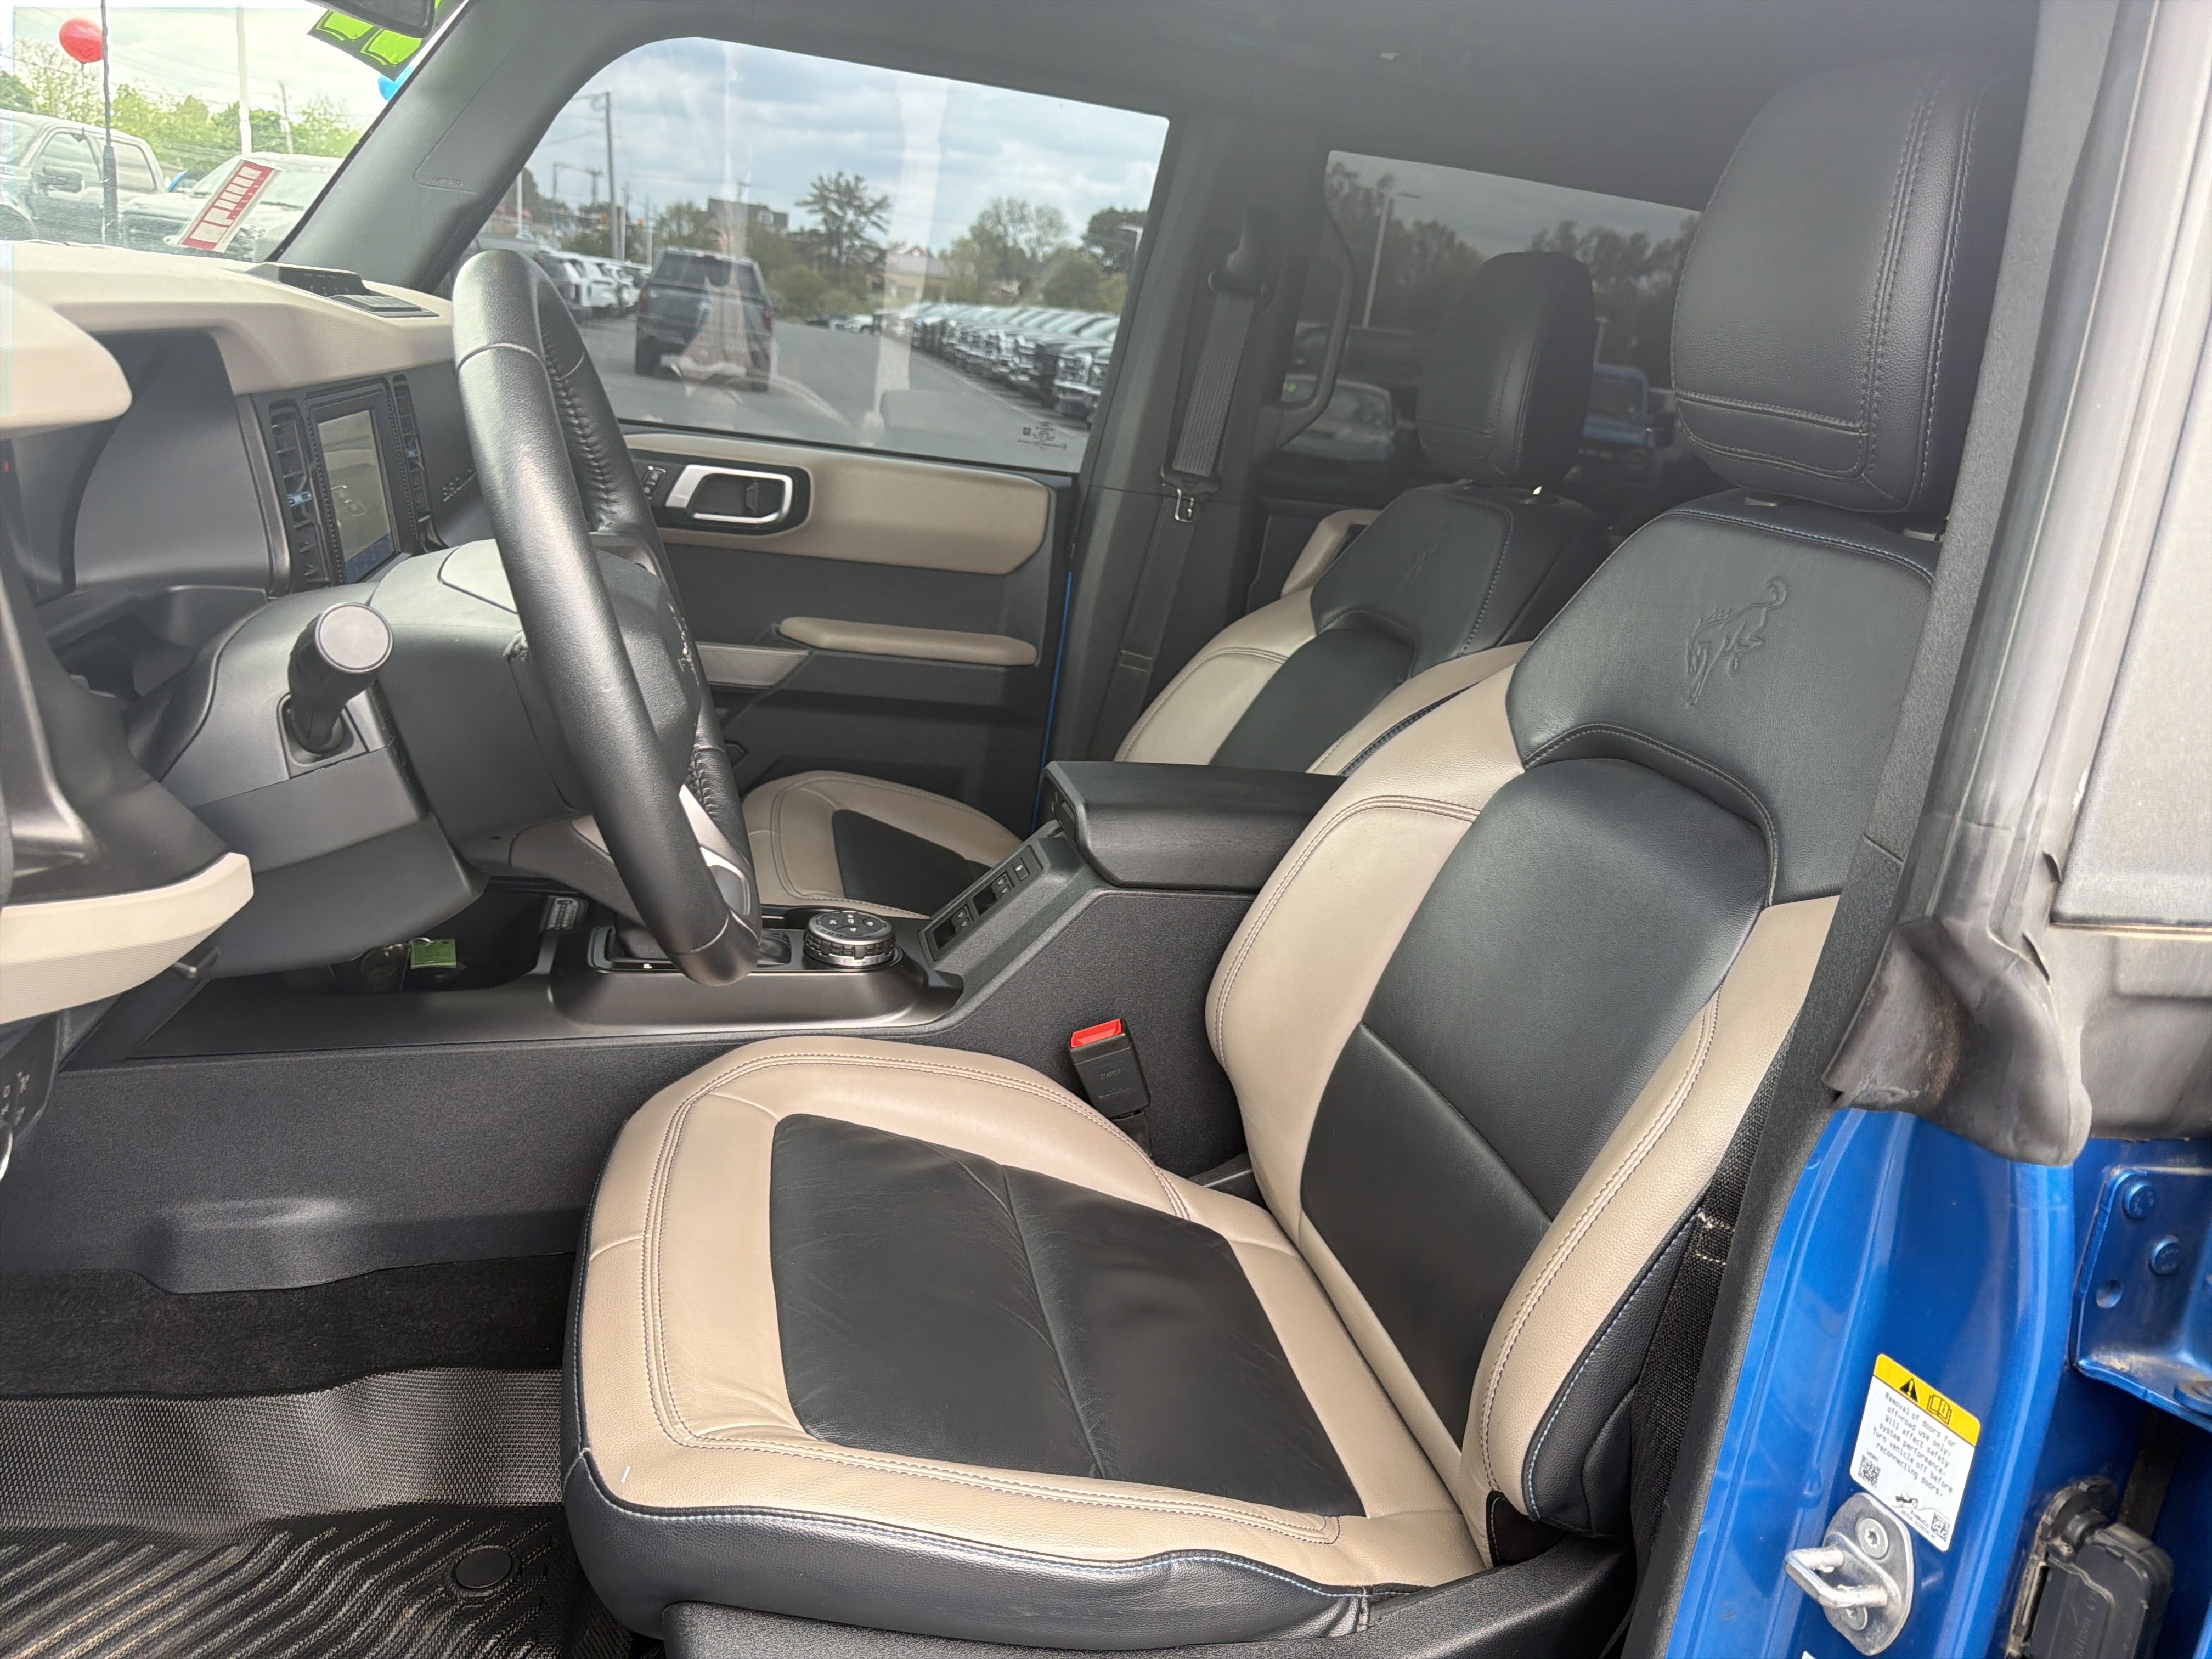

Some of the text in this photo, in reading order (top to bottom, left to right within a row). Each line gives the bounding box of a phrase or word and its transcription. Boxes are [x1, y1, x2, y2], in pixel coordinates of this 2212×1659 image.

[1886, 1392, 1909, 1415] Removal
[1922, 1421, 1940, 1437] doors
[1945, 1436, 1956, 1447] for
[1886, 1415, 1949, 1468] Will affect safety
[1888, 1407, 1951, 1457] off-road use only.
[1874, 1427, 1952, 1493] Turn vehicle off before
[1876, 1443, 1943, 1497] reconnecting doors.
[1880, 1423, 1946, 1476] system performance.
